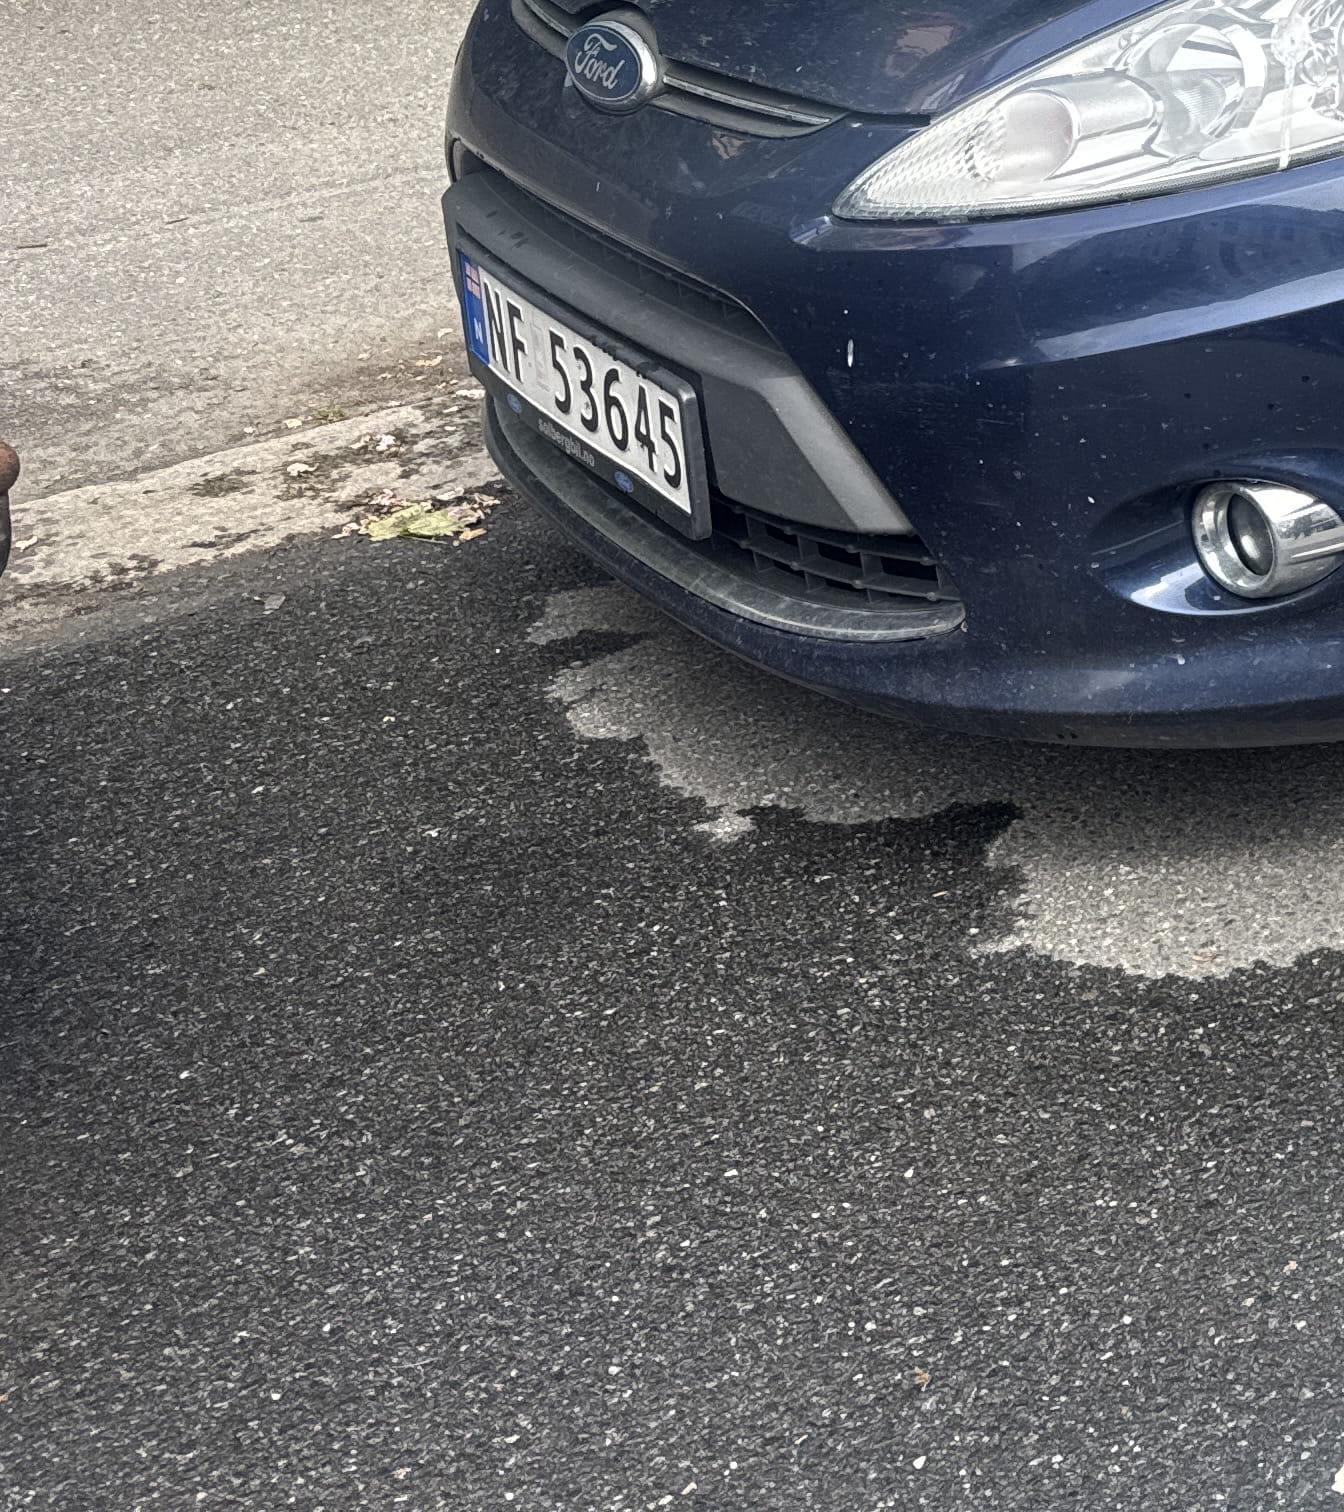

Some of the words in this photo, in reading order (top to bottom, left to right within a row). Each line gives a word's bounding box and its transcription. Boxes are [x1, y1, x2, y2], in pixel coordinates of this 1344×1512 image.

[574, 32, 626, 90] Ford
[473, 317, 484, 344] N
[484, 279, 527, 384] NF
[549, 326, 682, 489] 53645
